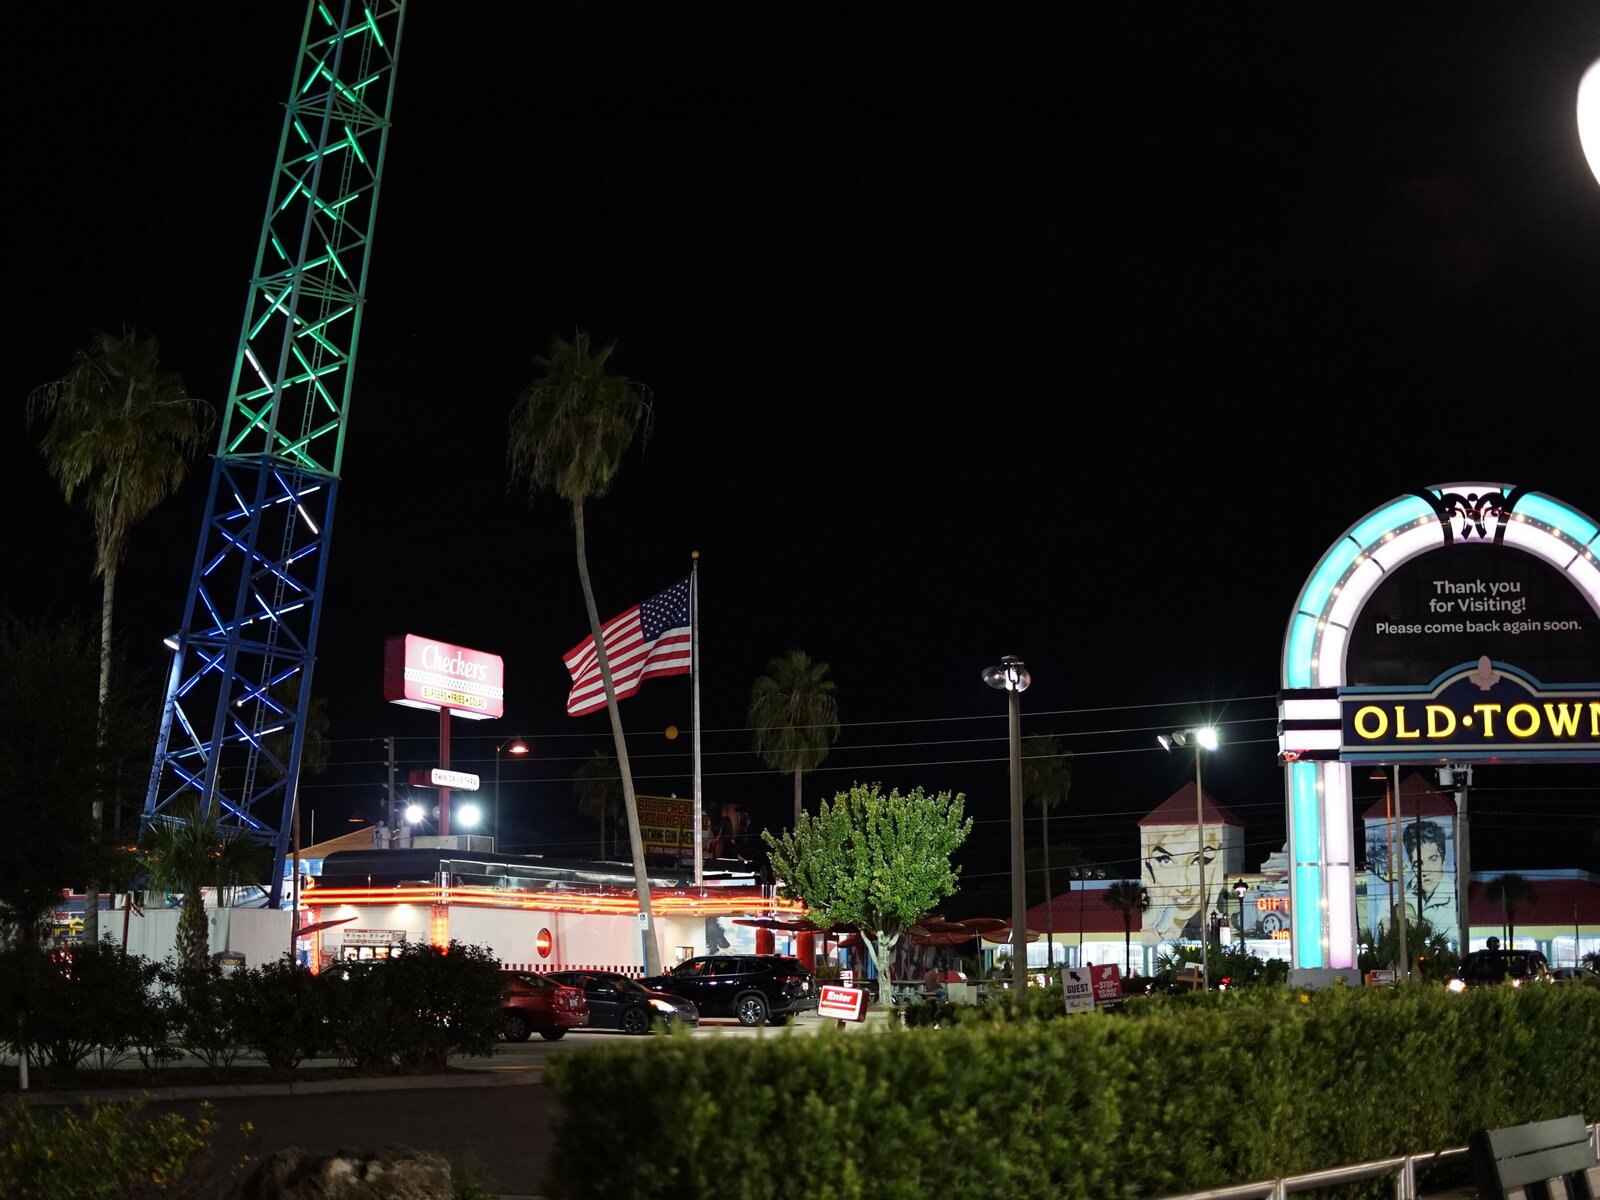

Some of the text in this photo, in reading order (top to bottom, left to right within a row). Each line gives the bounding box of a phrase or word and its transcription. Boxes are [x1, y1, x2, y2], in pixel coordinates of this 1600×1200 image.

[1433, 579, 1521, 596] Thank you
[1429, 597, 1526, 615] for Visiting!
[1376, 619, 1582, 634] Please come back again soon.
[421, 645, 488, 681] Checkers
[424, 687, 447, 701] BURGERS
[451, 693, 466, 705] FRIES
[1354, 705, 1456, 739] OLD
[1256, 897, 1291, 911] GIFT
[1067, 983, 1089, 993] GUEST
[1099, 981, 1114, 989] STOP
[827, 991, 852, 1002] Enter
